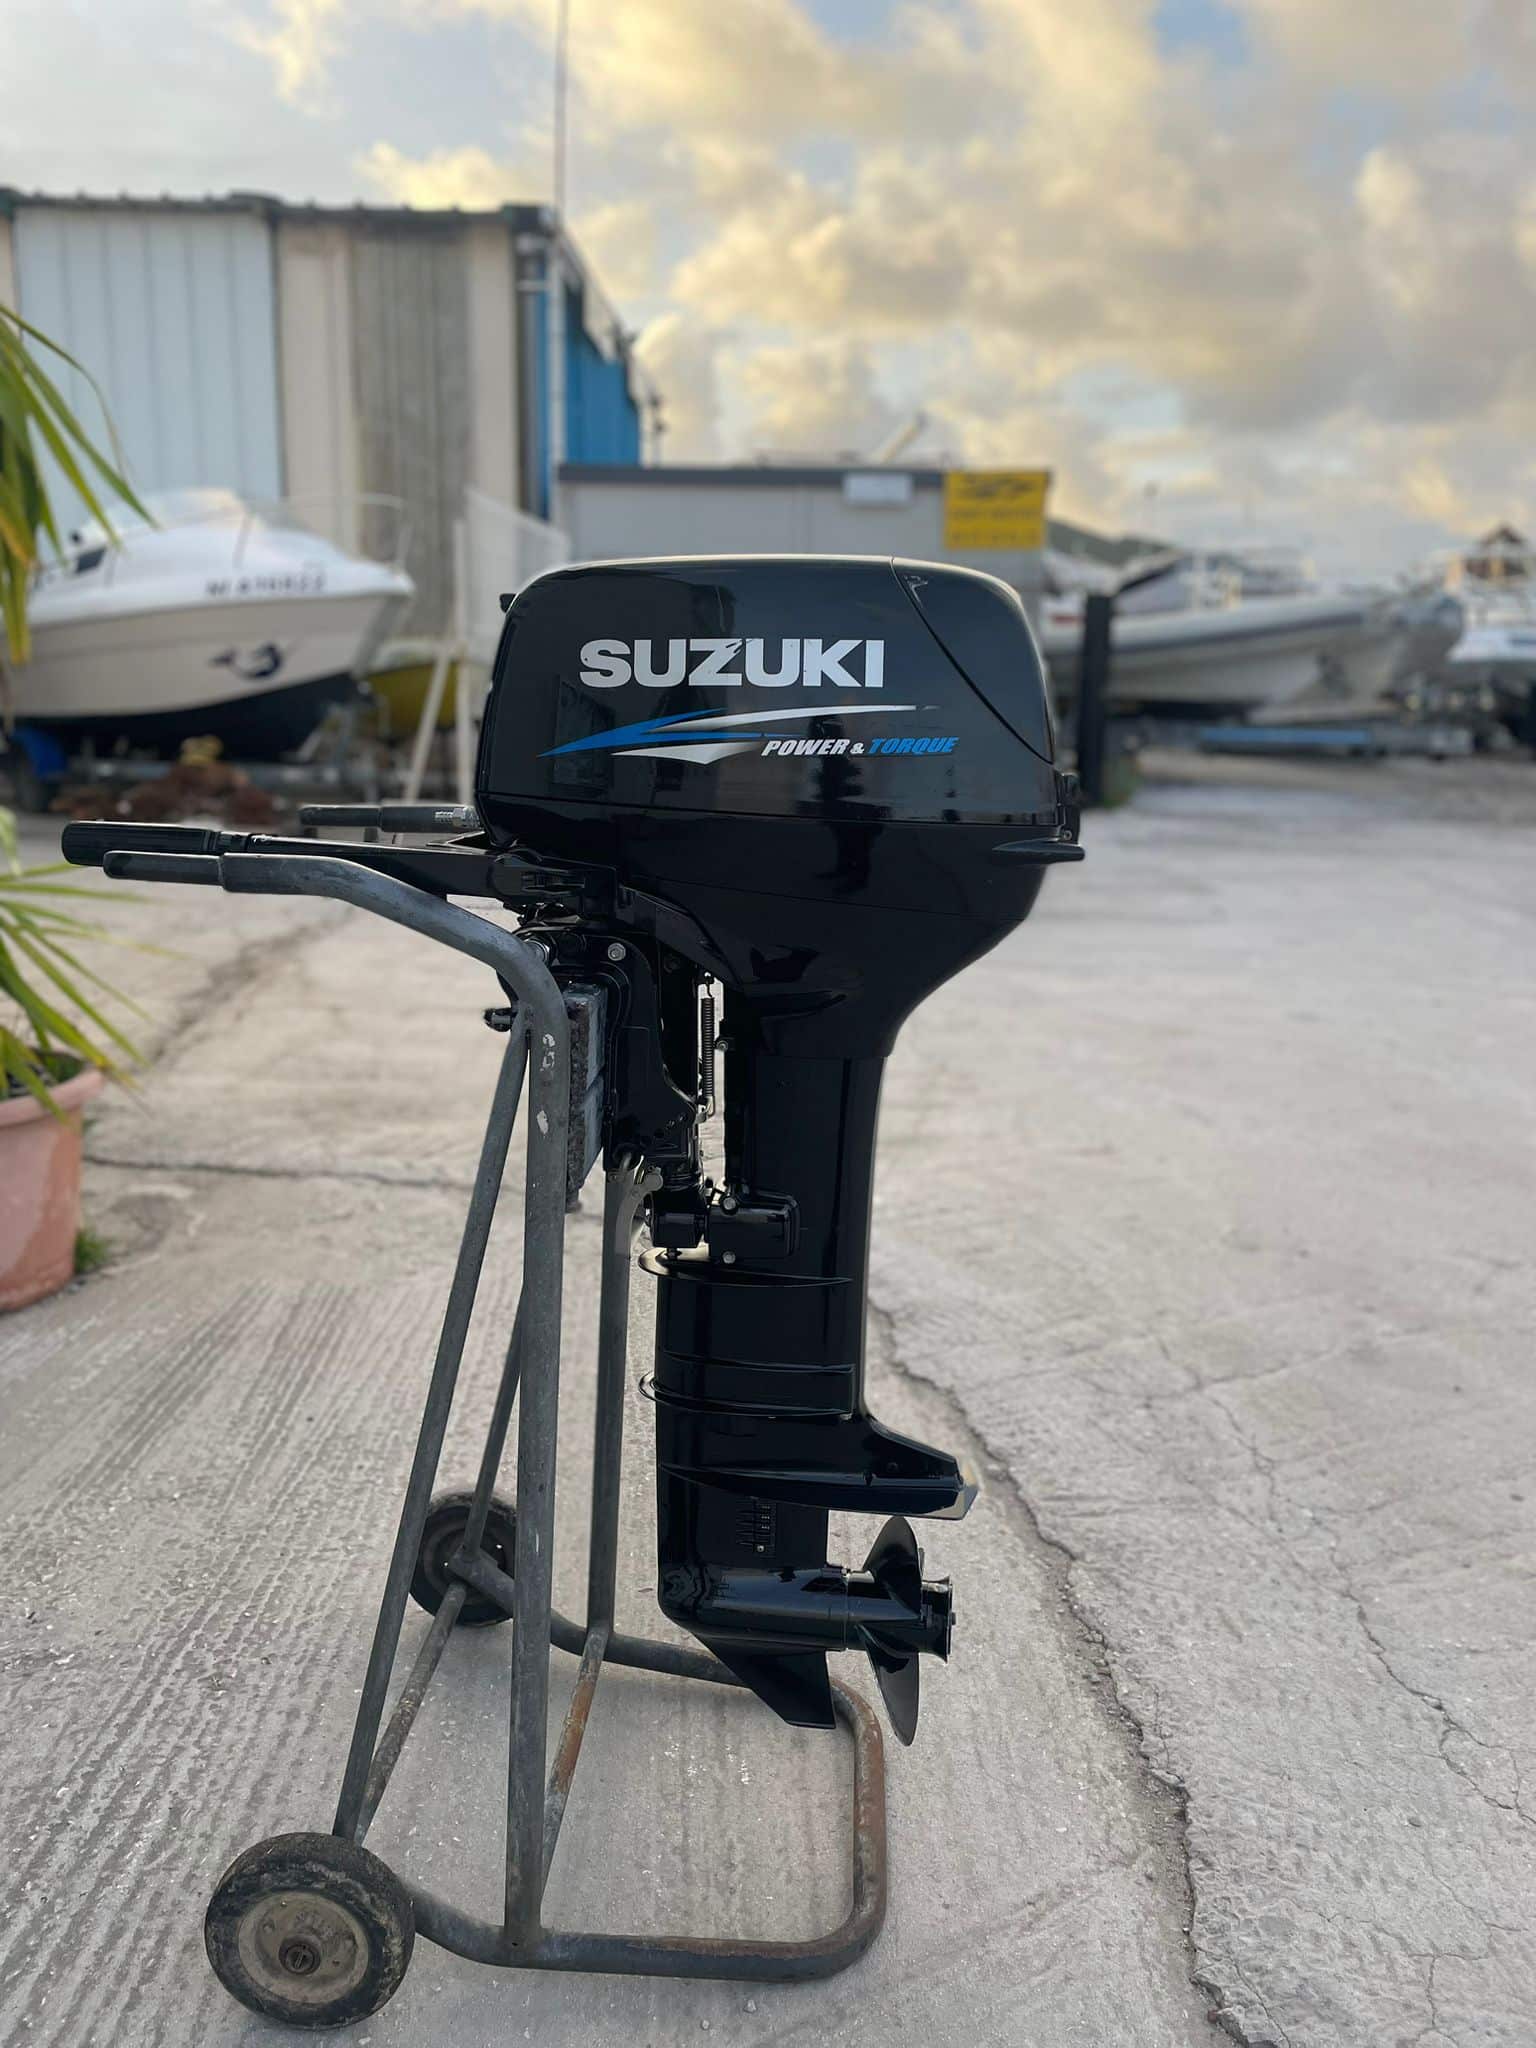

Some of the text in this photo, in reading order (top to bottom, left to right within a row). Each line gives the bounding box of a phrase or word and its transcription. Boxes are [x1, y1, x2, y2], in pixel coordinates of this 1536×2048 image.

[579, 639, 884, 688] SUZUKI
[761, 737, 959, 756] POWER & TORQUE
